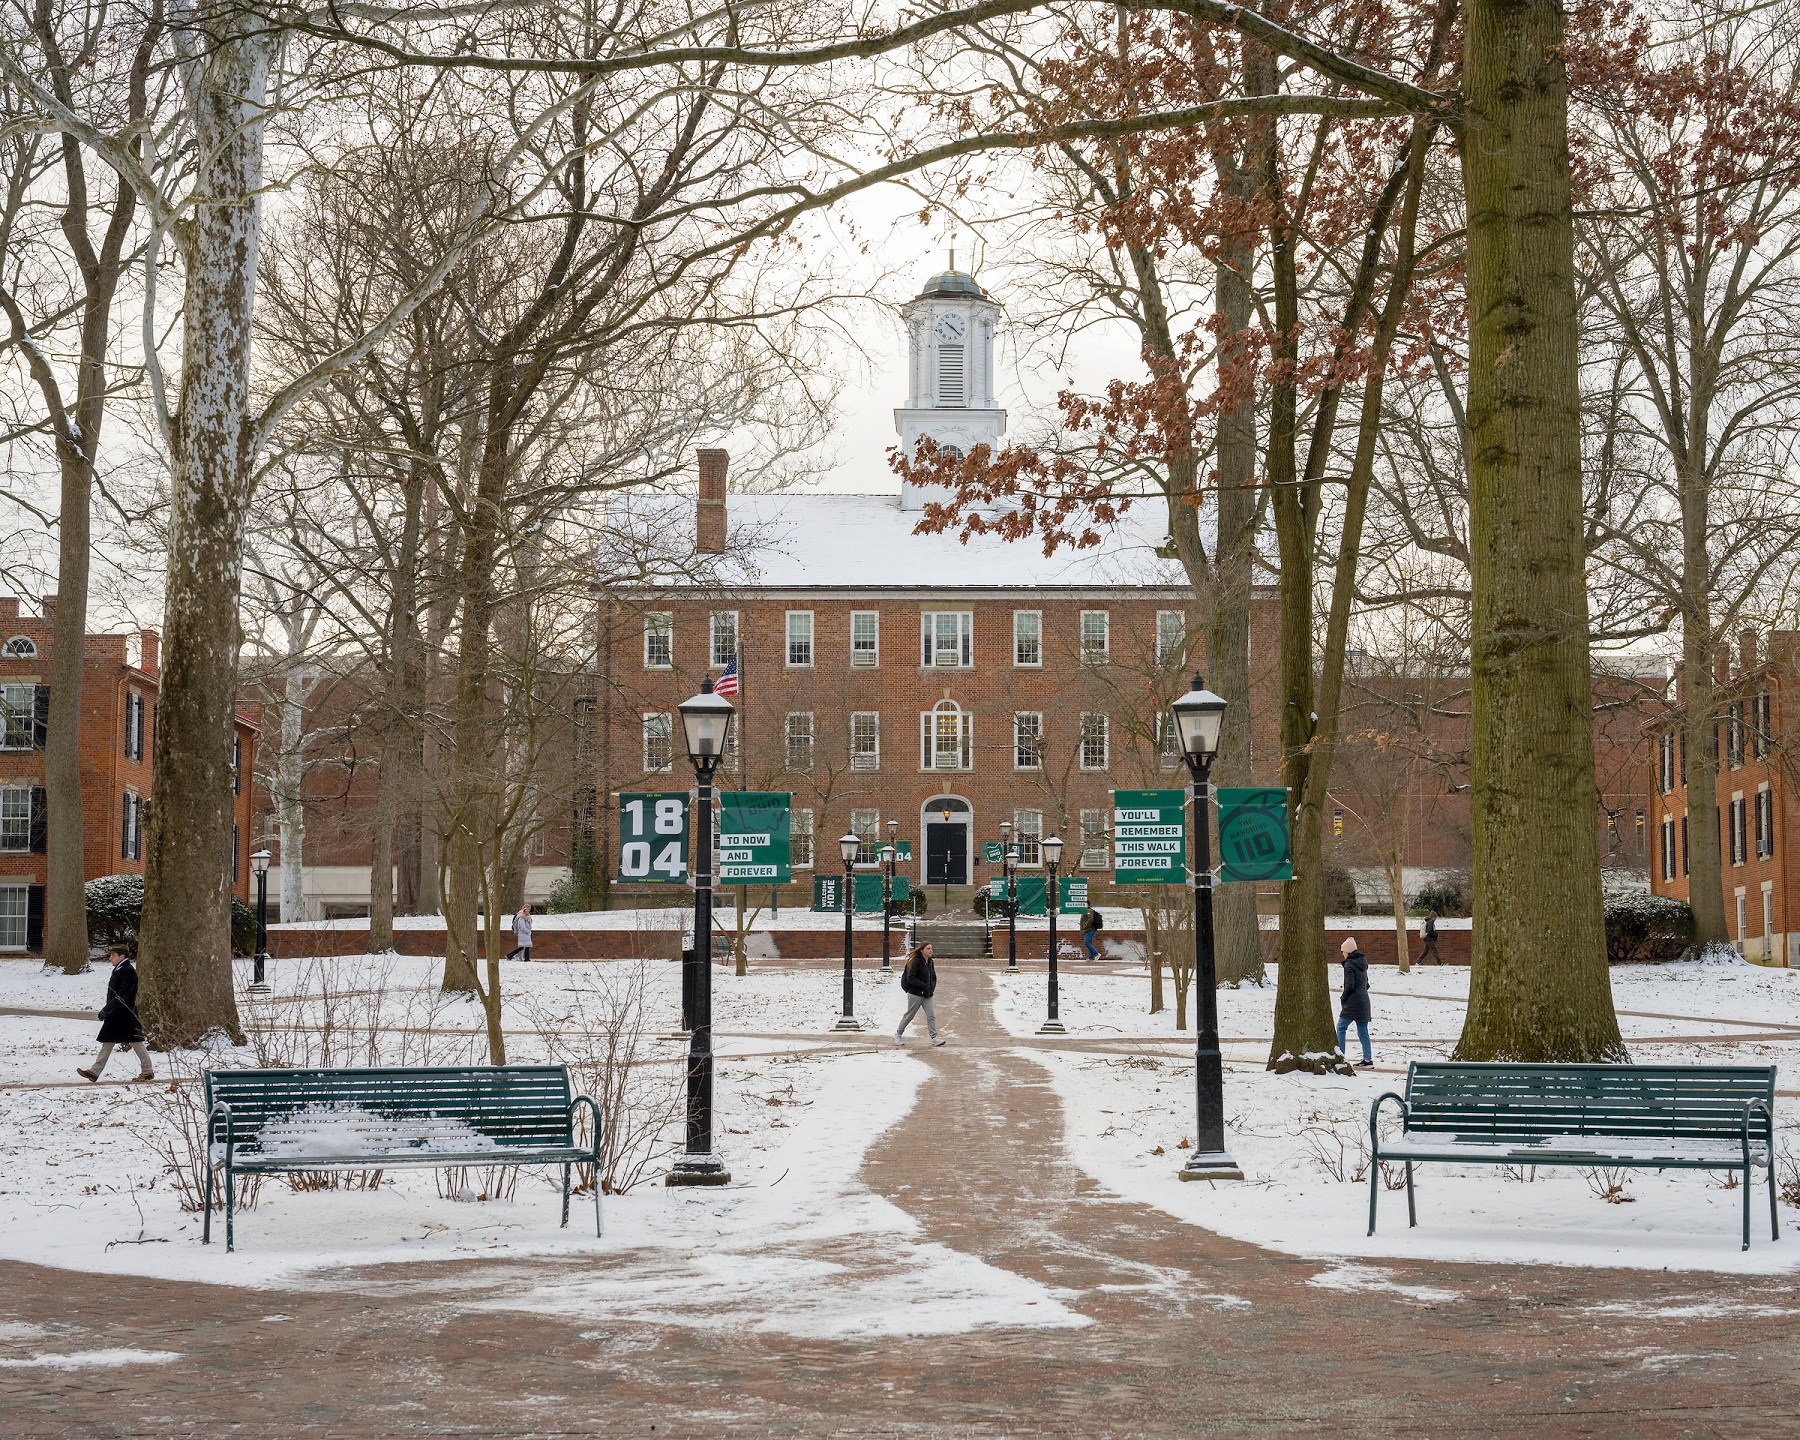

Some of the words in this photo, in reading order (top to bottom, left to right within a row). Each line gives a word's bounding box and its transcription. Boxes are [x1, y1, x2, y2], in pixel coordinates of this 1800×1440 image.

[625, 799, 684, 836] 18
[1121, 811, 1156, 820] YOU'LL
[1238, 817, 1254, 828] THE
[1121, 827, 1178, 836] REMEMBER
[1228, 820, 1269, 840] MARCHING
[726, 836, 740, 845] TO
[742, 836, 766, 844] NOW
[1121, 843, 1145, 851] THIS
[1147, 842, 1176, 851] WALK
[621, 841, 687, 878] 04
[727, 852, 748, 860] AND
[1121, 858, 1167, 867] FOREVER
[727, 867, 773, 876] FOREVER
[827, 879, 835, 908] HOME
